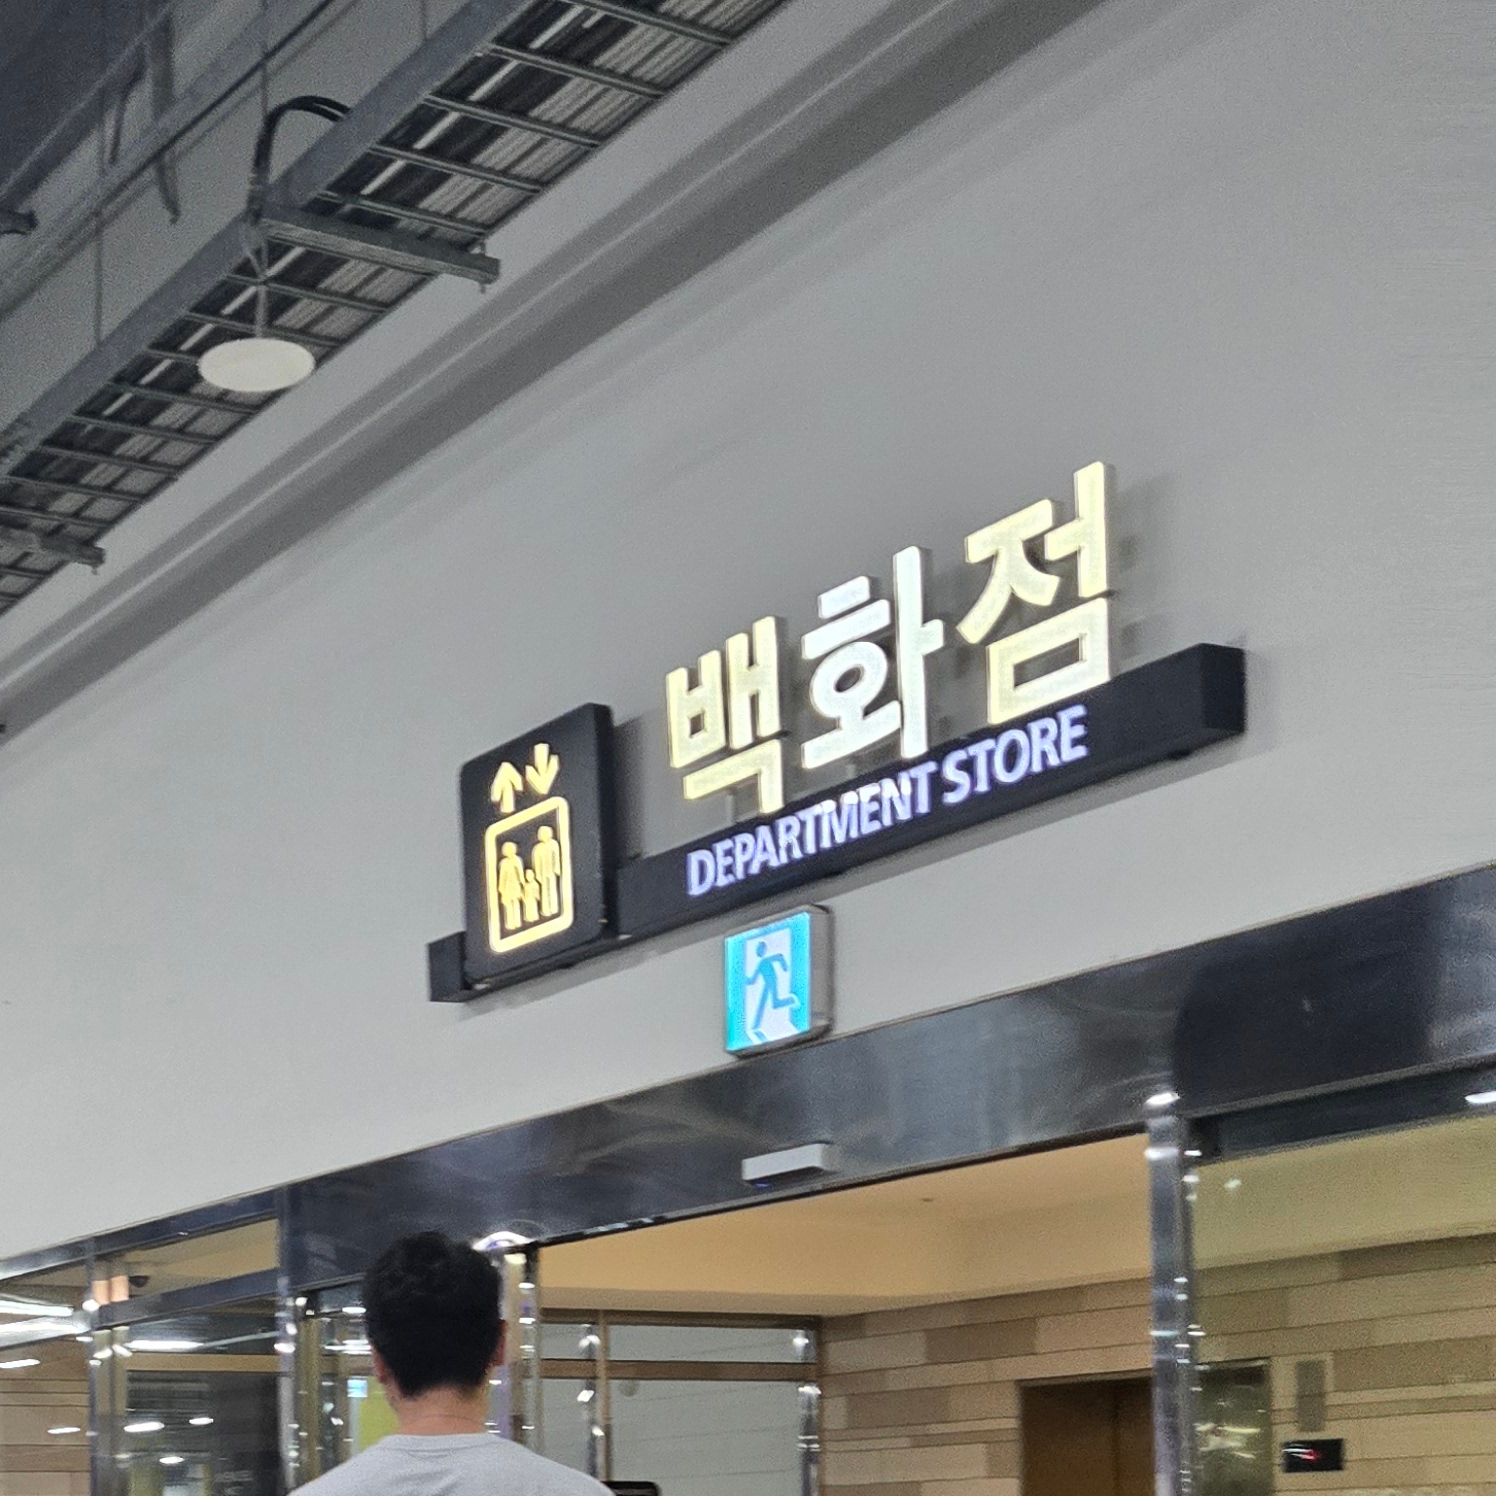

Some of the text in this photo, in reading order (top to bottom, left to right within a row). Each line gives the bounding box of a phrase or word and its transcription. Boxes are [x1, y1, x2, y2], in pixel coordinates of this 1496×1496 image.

[666, 461, 1110, 813] 백화점
[687, 704, 1089, 897] DEPARTMENT STORE
